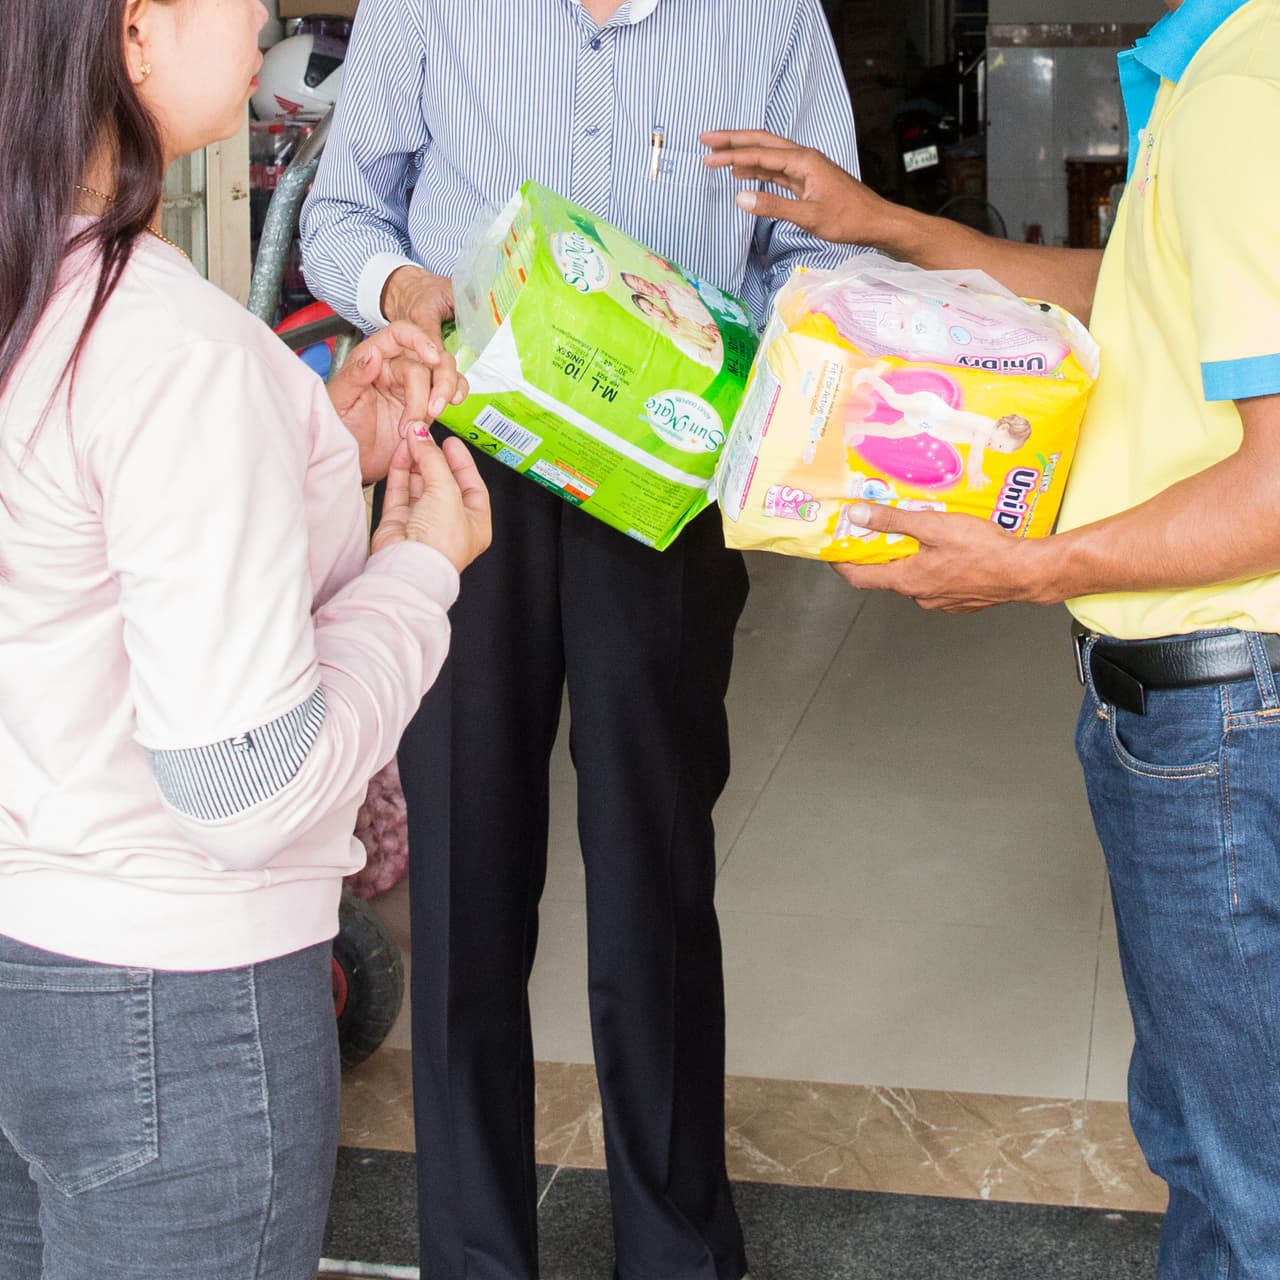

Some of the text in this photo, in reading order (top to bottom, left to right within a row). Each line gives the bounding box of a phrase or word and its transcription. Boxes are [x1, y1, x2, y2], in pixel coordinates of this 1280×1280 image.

[564, 363, 617, 402] M-L 10
[783, 485, 804, 502] S
